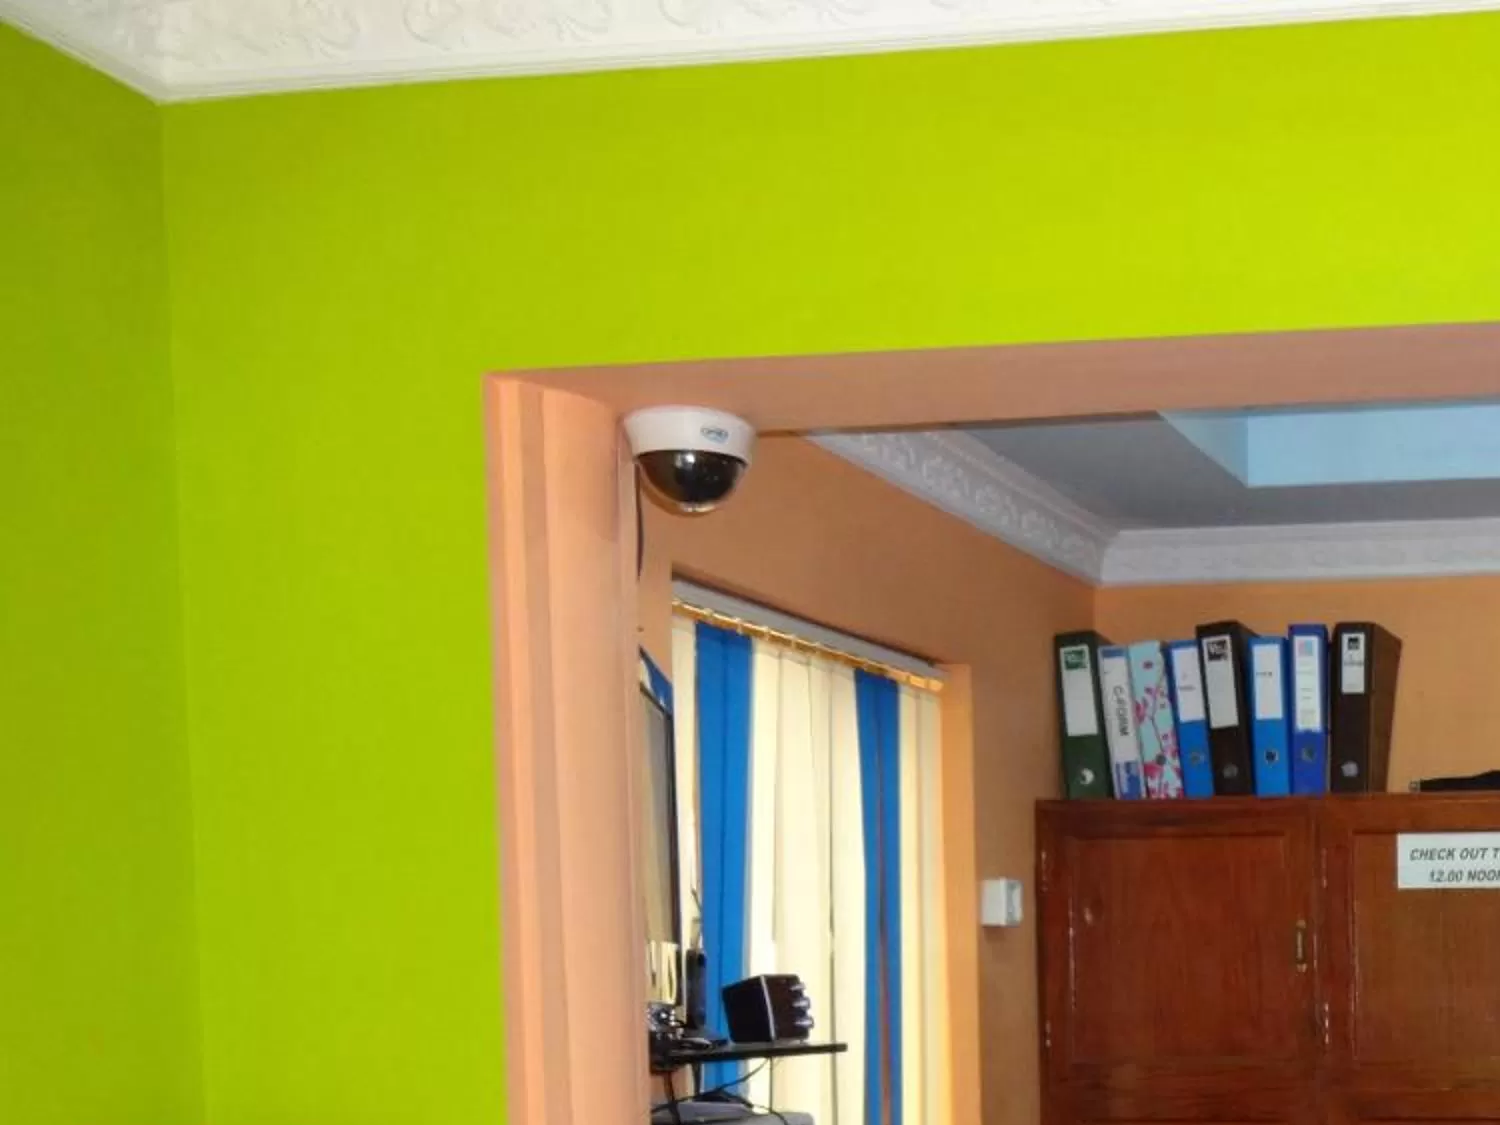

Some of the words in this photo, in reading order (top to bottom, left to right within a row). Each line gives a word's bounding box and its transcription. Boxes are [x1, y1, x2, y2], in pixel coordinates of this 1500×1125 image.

[1409, 847, 1456, 861] CHECK
[1459, 847, 1489, 861] OUT
[1429, 869, 1463, 883] 12.00
